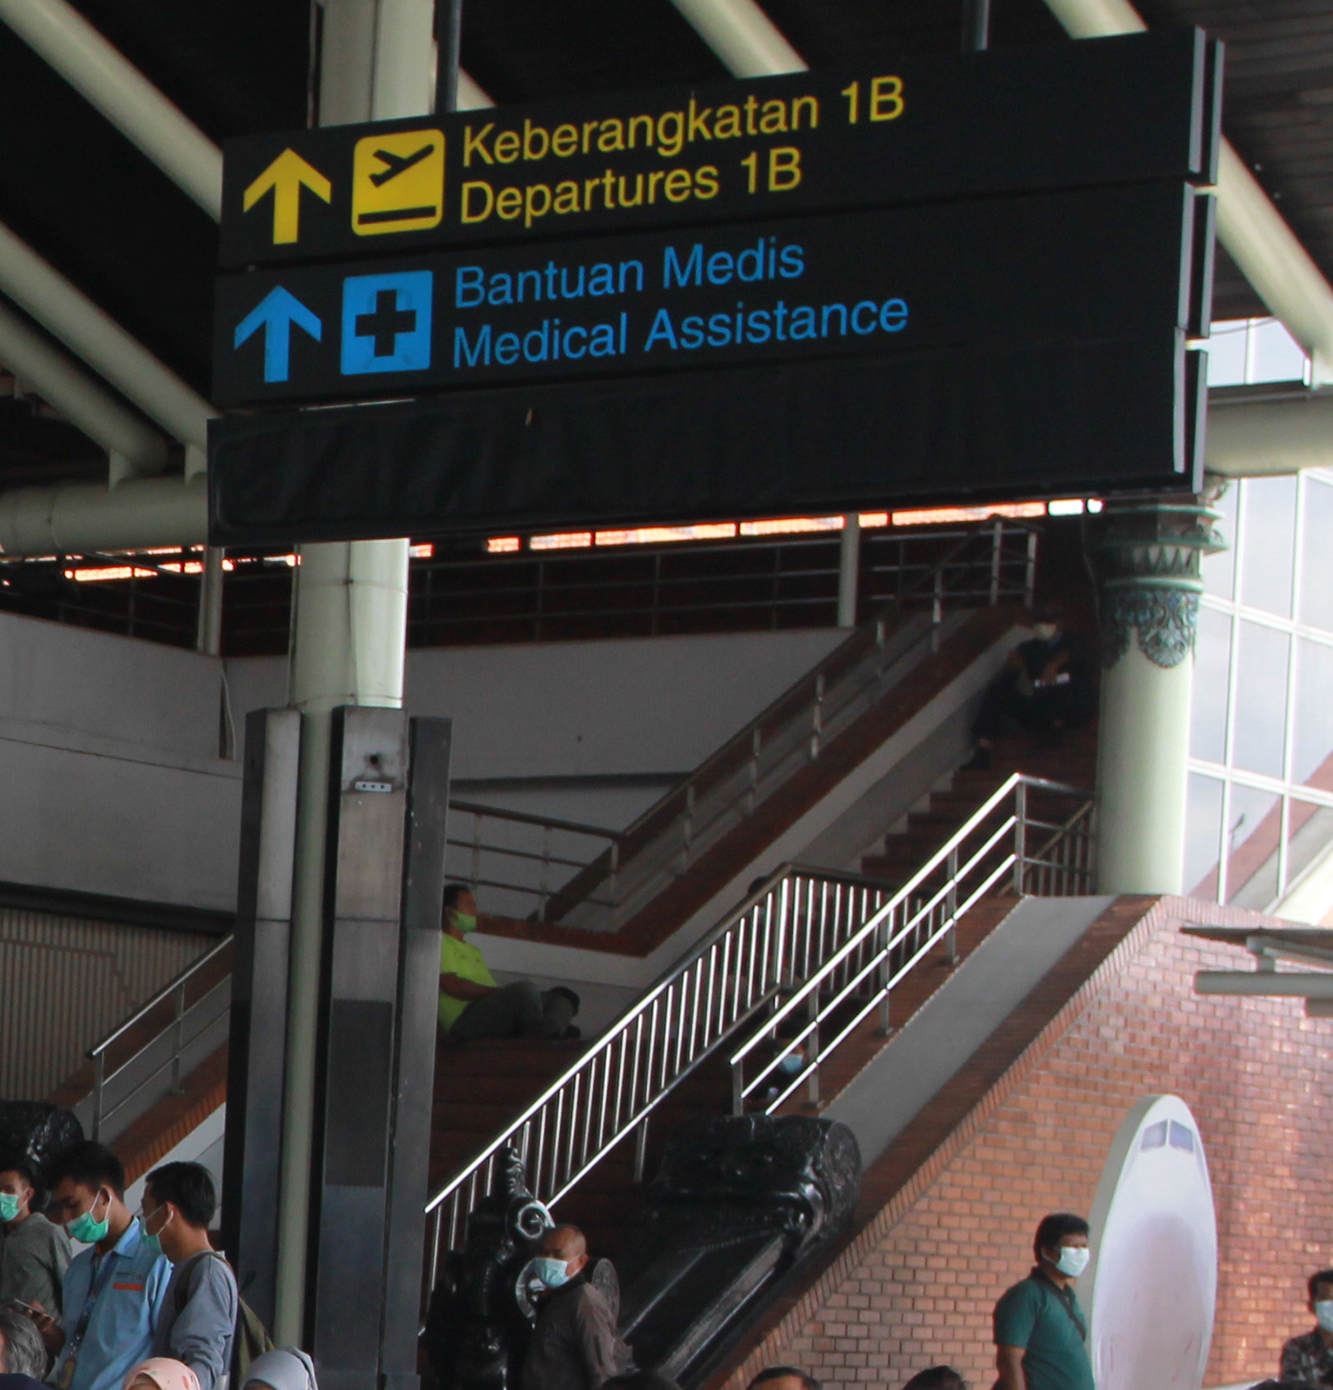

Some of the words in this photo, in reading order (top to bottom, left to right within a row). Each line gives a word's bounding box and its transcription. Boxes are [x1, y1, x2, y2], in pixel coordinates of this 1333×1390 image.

[462, 94, 819, 168] Keberangkatan
[842, 76, 904, 123] 1B
[461, 166, 720, 227] Departures
[741, 147, 801, 194] 1B
[456, 259, 644, 309] Bantuan
[664, 237, 805, 289] Medis
[454, 311, 628, 368] Medical
[644, 297, 909, 352] Assistance
